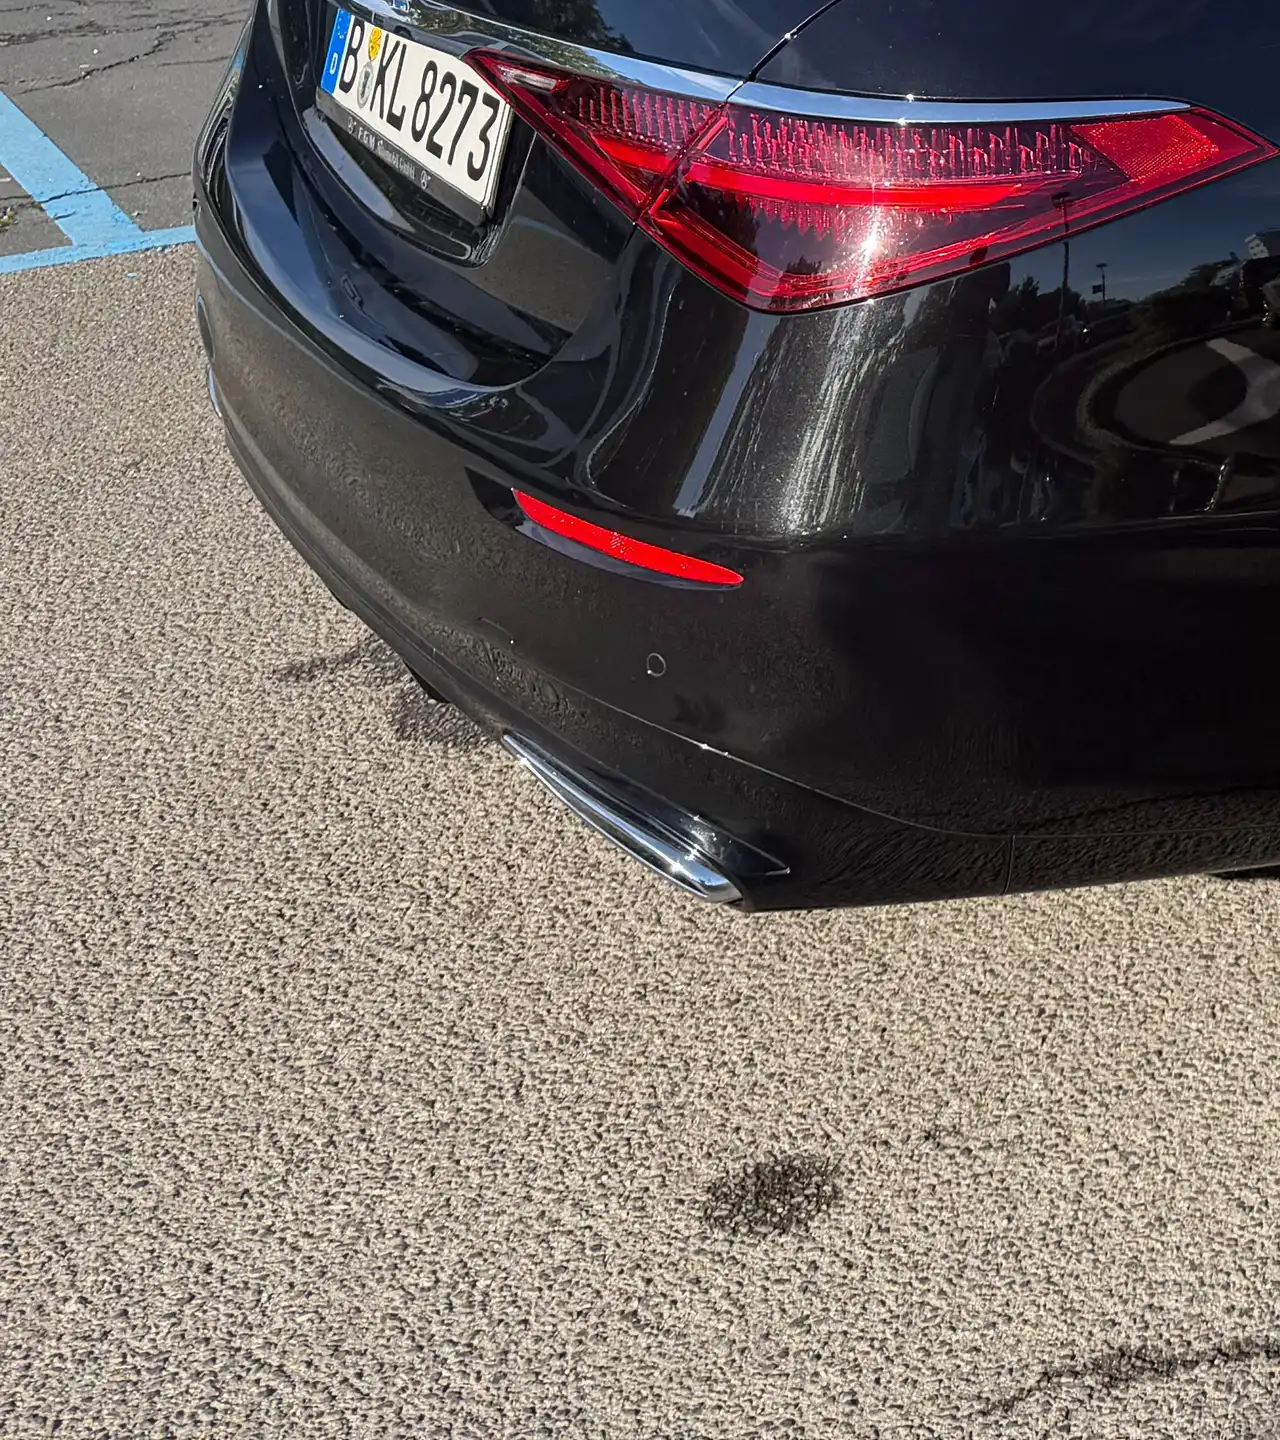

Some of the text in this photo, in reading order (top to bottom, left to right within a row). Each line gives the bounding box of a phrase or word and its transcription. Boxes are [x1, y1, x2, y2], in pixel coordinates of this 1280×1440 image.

[329, 52, 338, 75] D
[338, 19, 501, 182] B KL 8273
